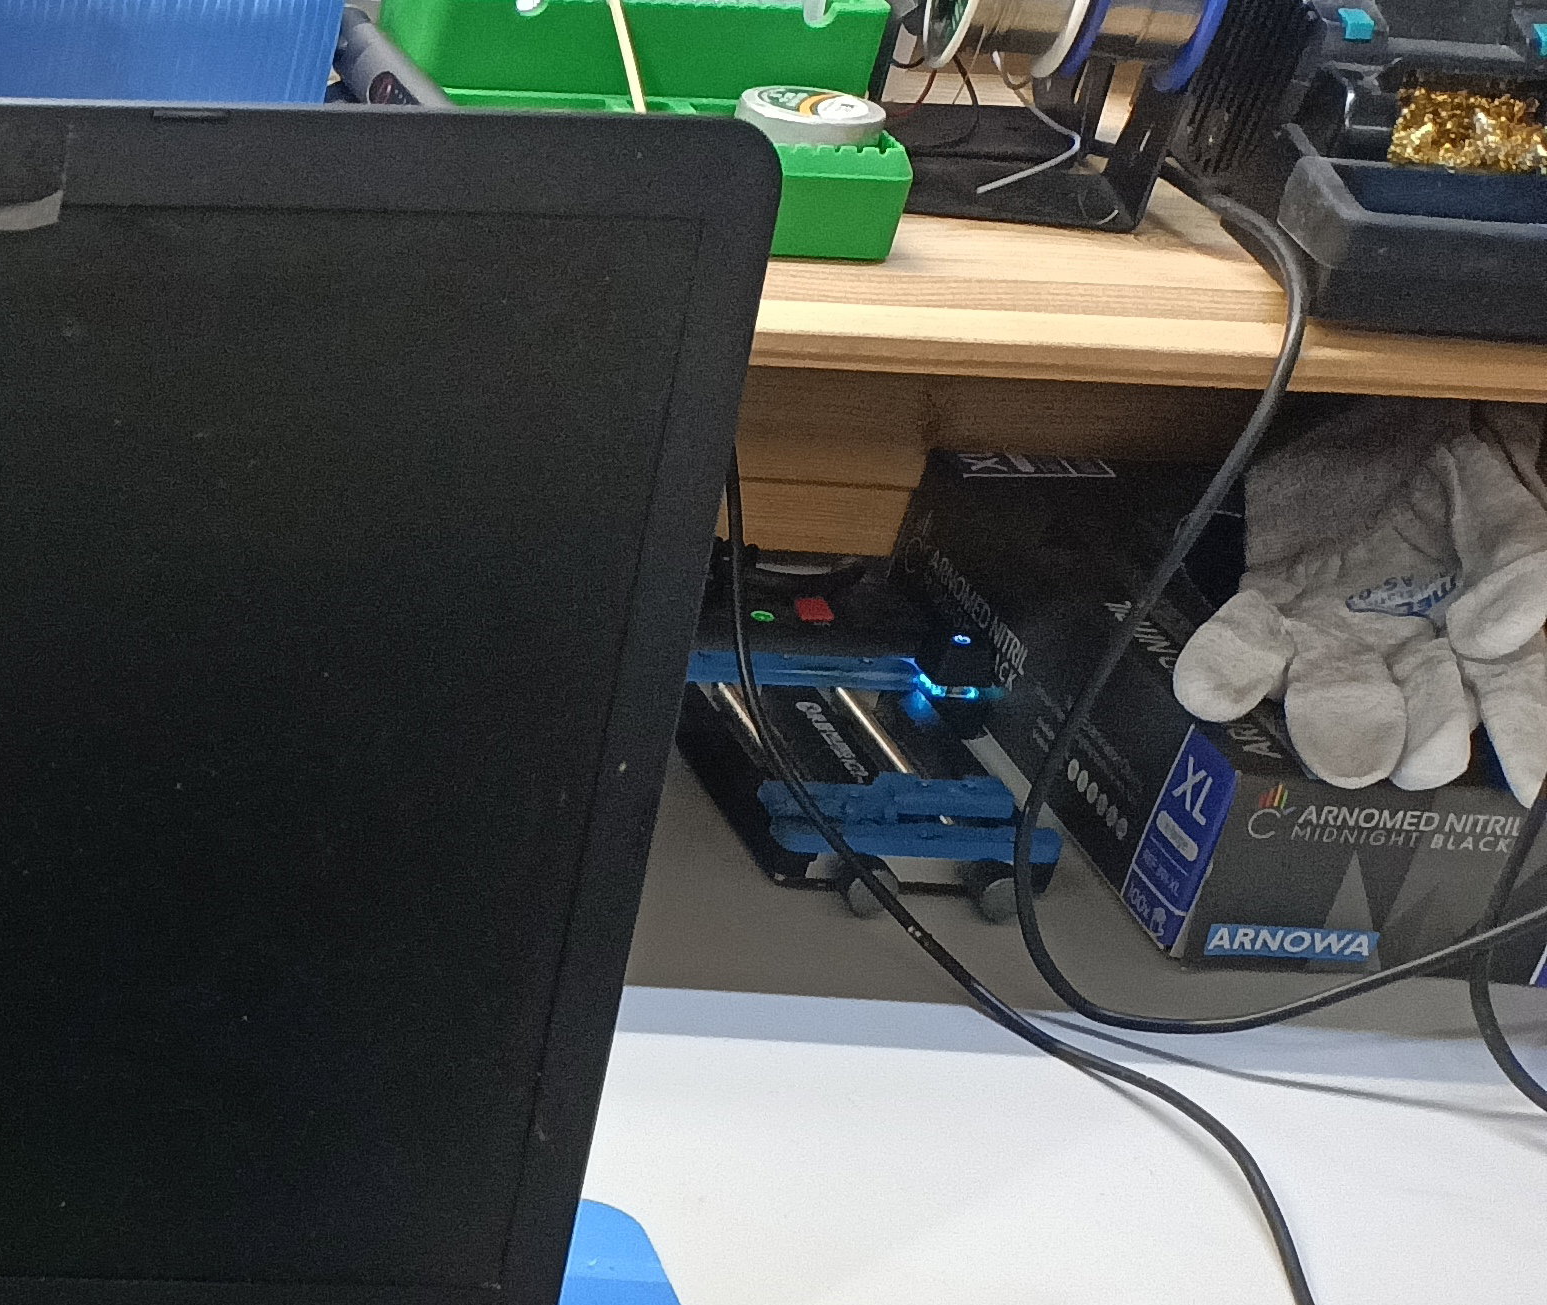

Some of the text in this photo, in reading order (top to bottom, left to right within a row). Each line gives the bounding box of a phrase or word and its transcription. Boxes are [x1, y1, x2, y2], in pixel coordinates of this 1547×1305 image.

[1171, 756, 1213, 825] XL
[1297, 805, 1525, 836] ARNOMED NITRIL
[1291, 823, 1516, 854] MIDNIGHT BLACK
[1207, 926, 1371, 957] ARNOWA
